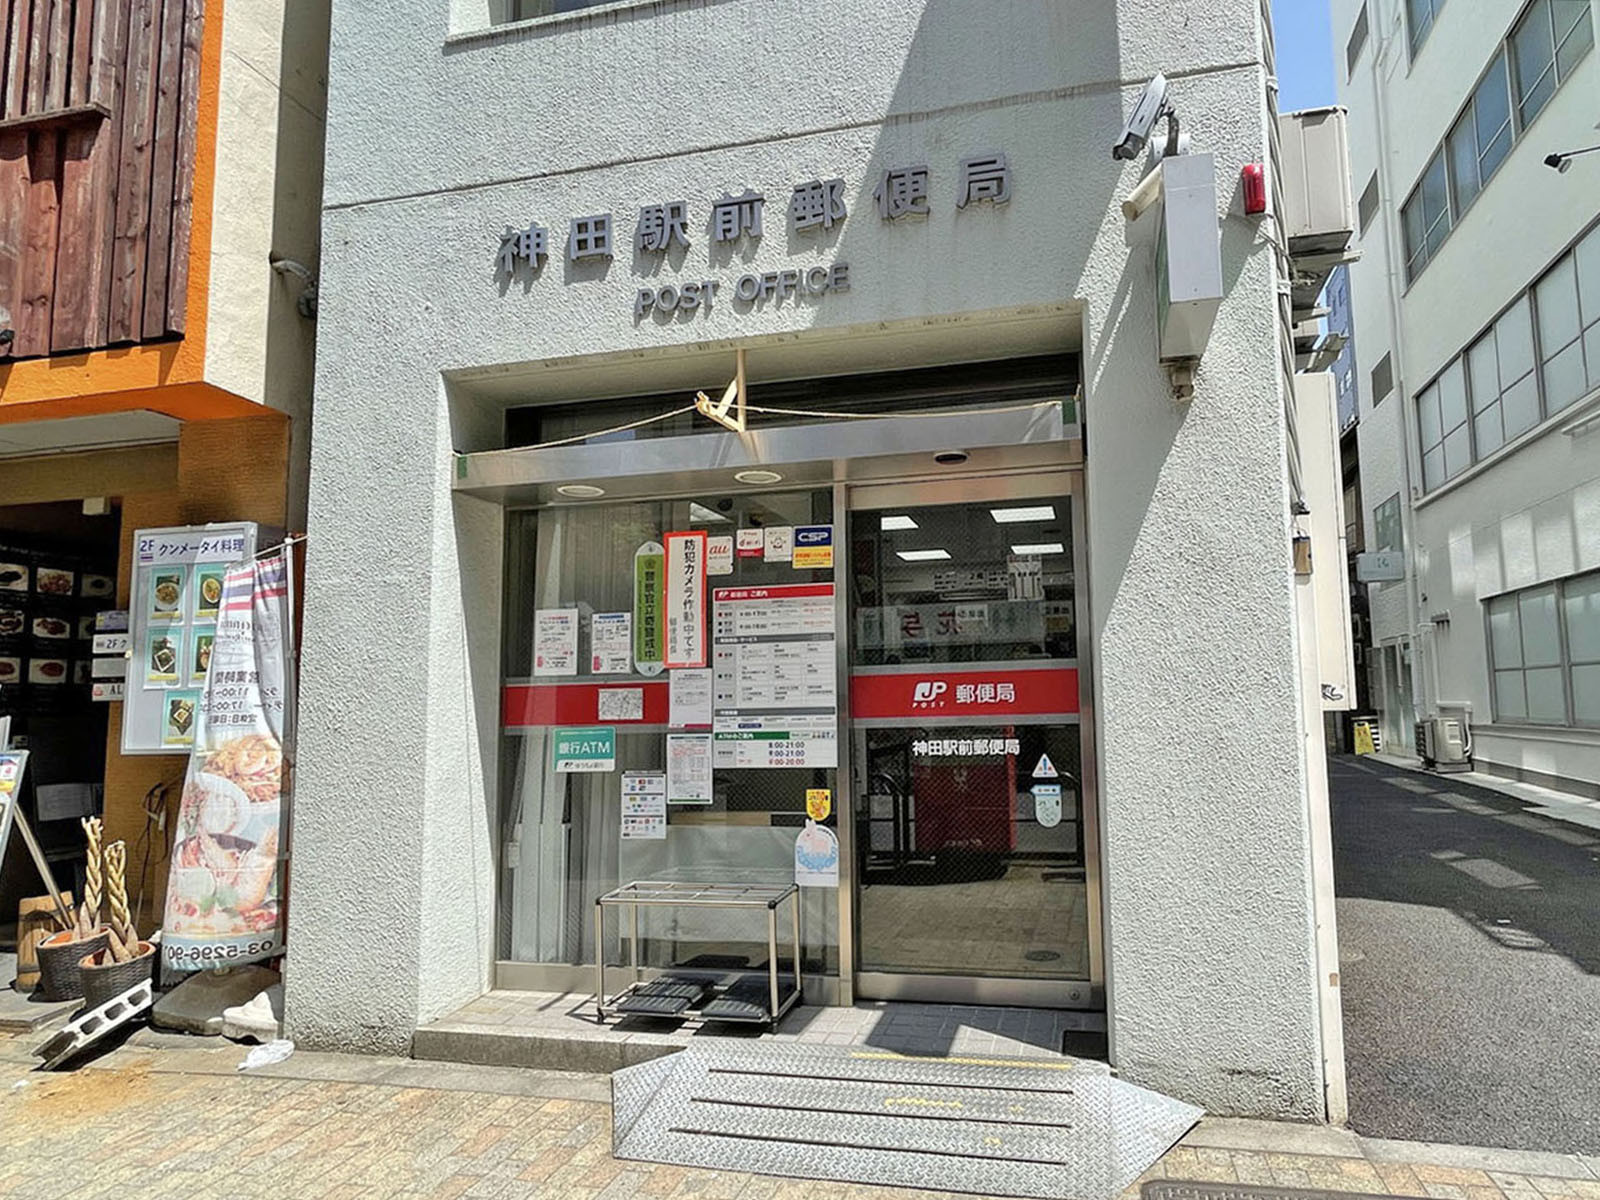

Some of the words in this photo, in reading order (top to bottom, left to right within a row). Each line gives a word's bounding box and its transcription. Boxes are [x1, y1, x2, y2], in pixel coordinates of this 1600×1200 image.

[501, 153, 1012, 272] 神田駅前郵便局
[635, 281, 720, 315] POST
[736, 262, 850, 303] OFFICE
[798, 532, 829, 542] CSP
[140, 540, 154, 552] 2F
[158, 538, 244, 557] クンメータイ料理
[709, 545, 729, 555] au
[956, 683, 1015, 704] 郵便局
[559, 740, 610, 754] 銀行ATM
[912, 738, 1020, 756] 神田駅前郵便局
